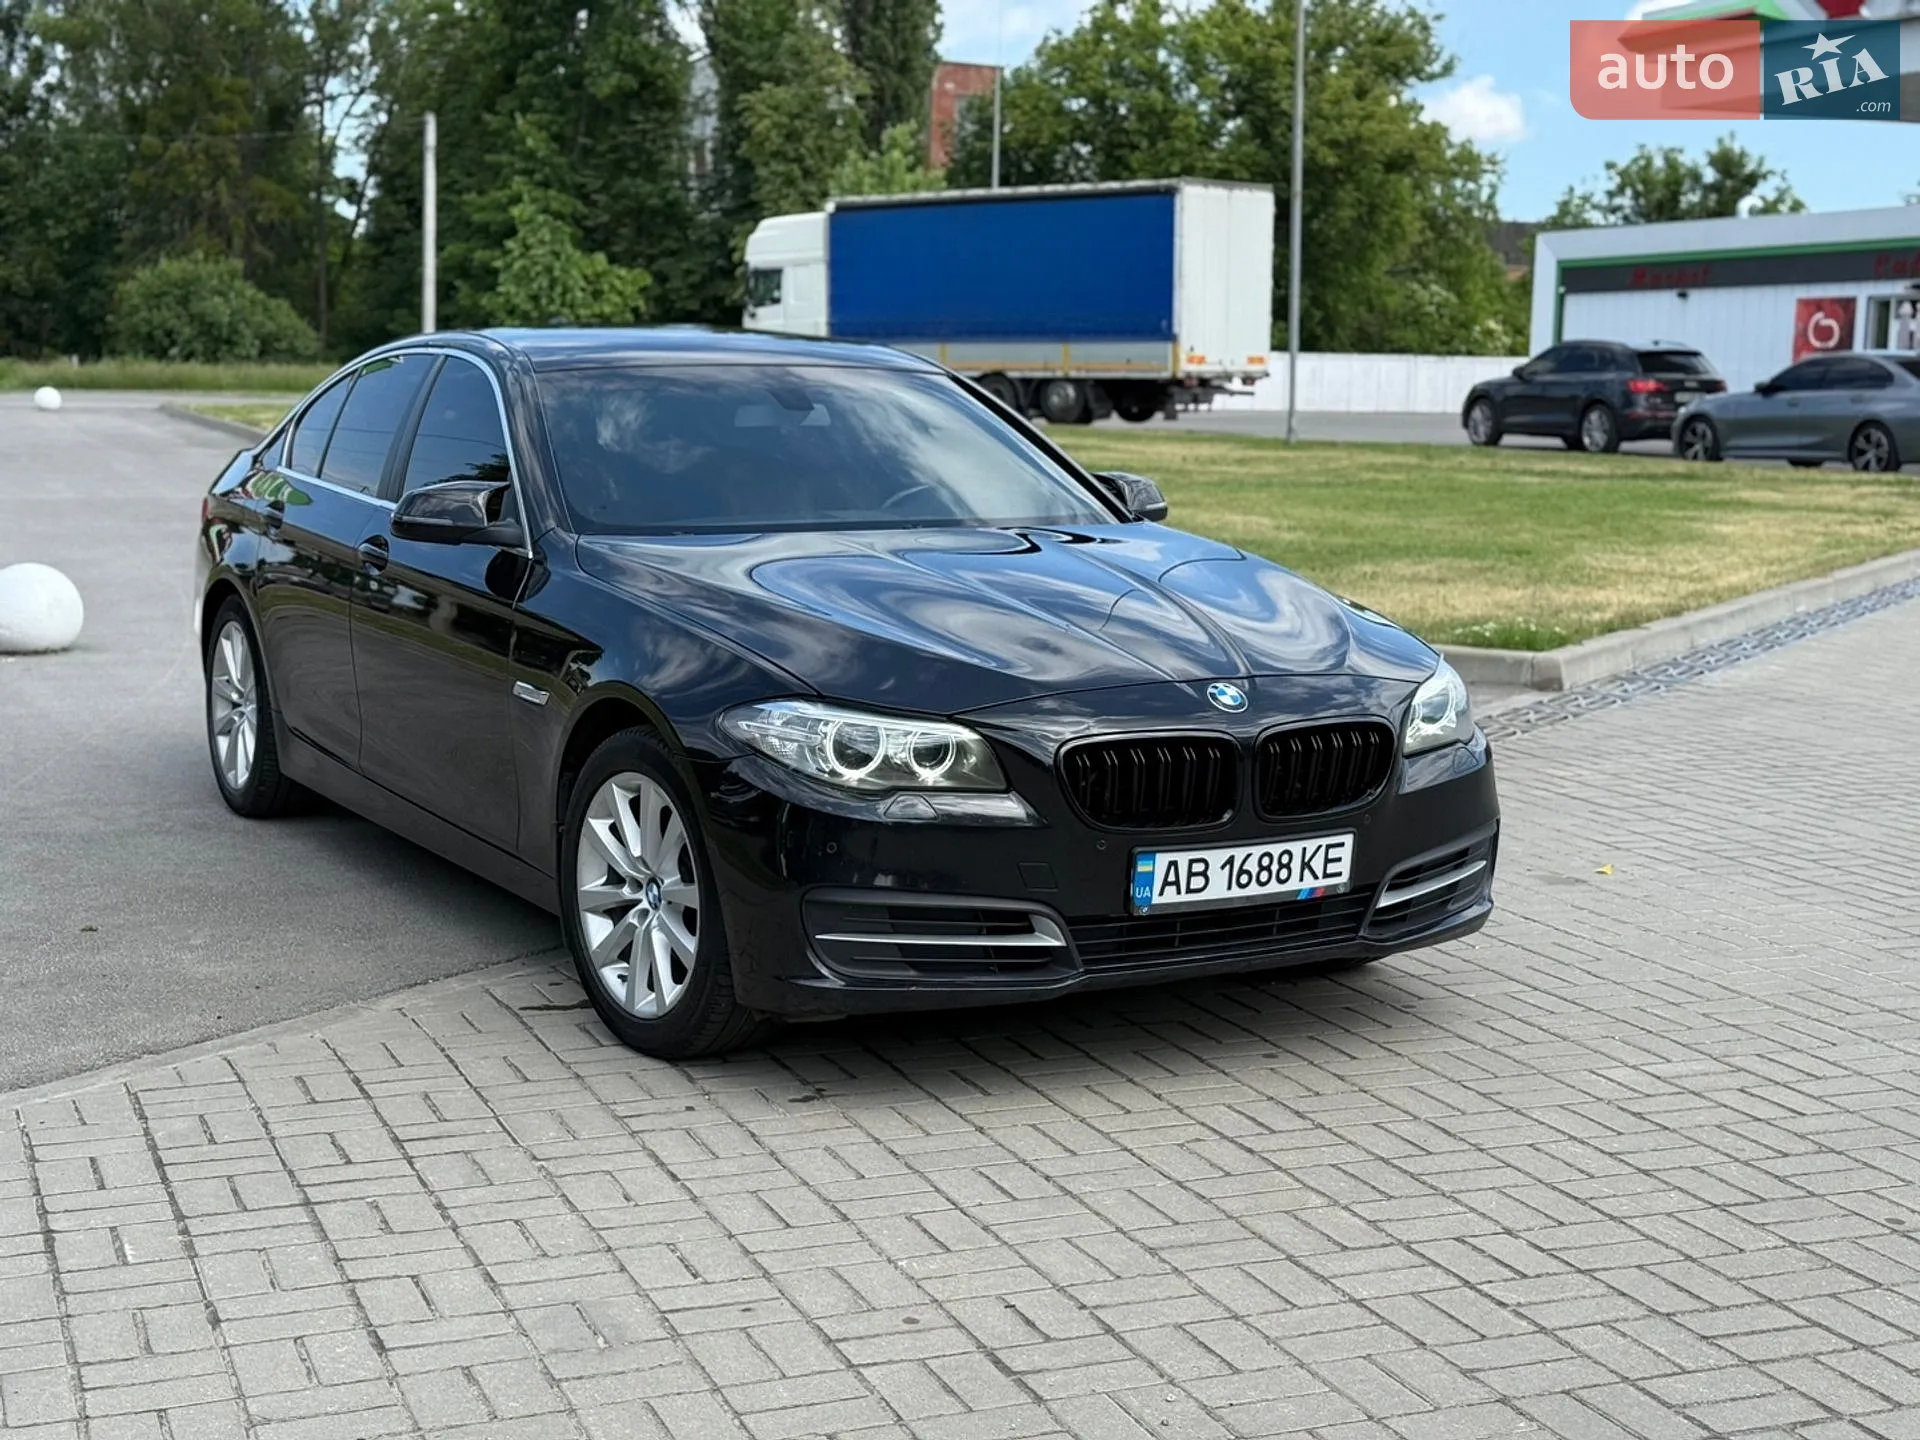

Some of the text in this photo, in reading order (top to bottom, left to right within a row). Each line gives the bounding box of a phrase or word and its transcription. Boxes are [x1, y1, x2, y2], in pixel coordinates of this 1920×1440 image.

[1158, 841, 1346, 897] AB 1688 KE
[1135, 886, 1152, 898] UA
